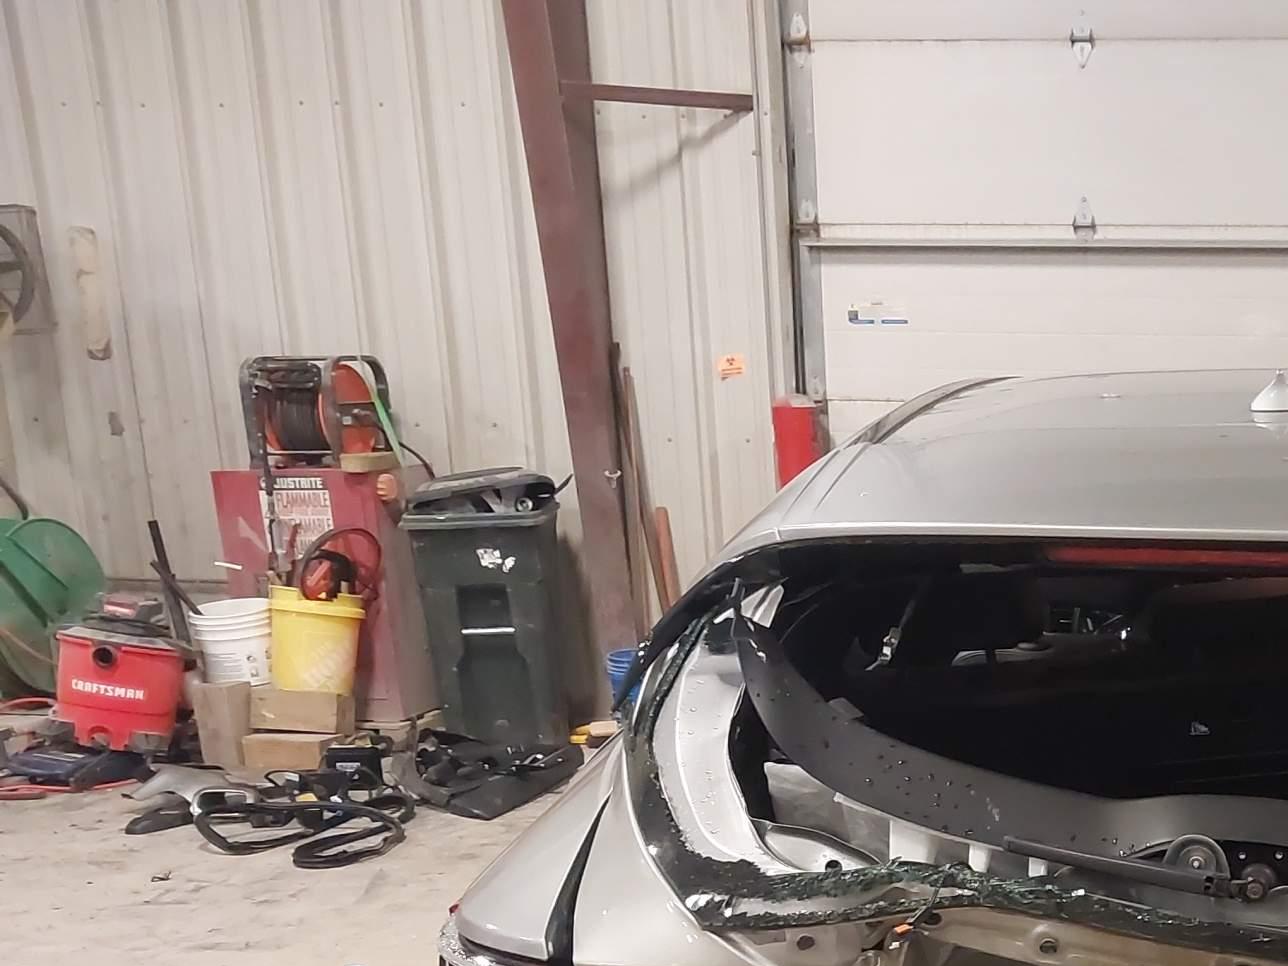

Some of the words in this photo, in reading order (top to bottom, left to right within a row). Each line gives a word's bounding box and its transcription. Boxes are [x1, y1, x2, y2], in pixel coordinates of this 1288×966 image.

[273, 477, 324, 489] JUSTRITE
[275, 491, 329, 508] FLAMMABLE
[71, 678, 145, 700] CRAFTSMAN
